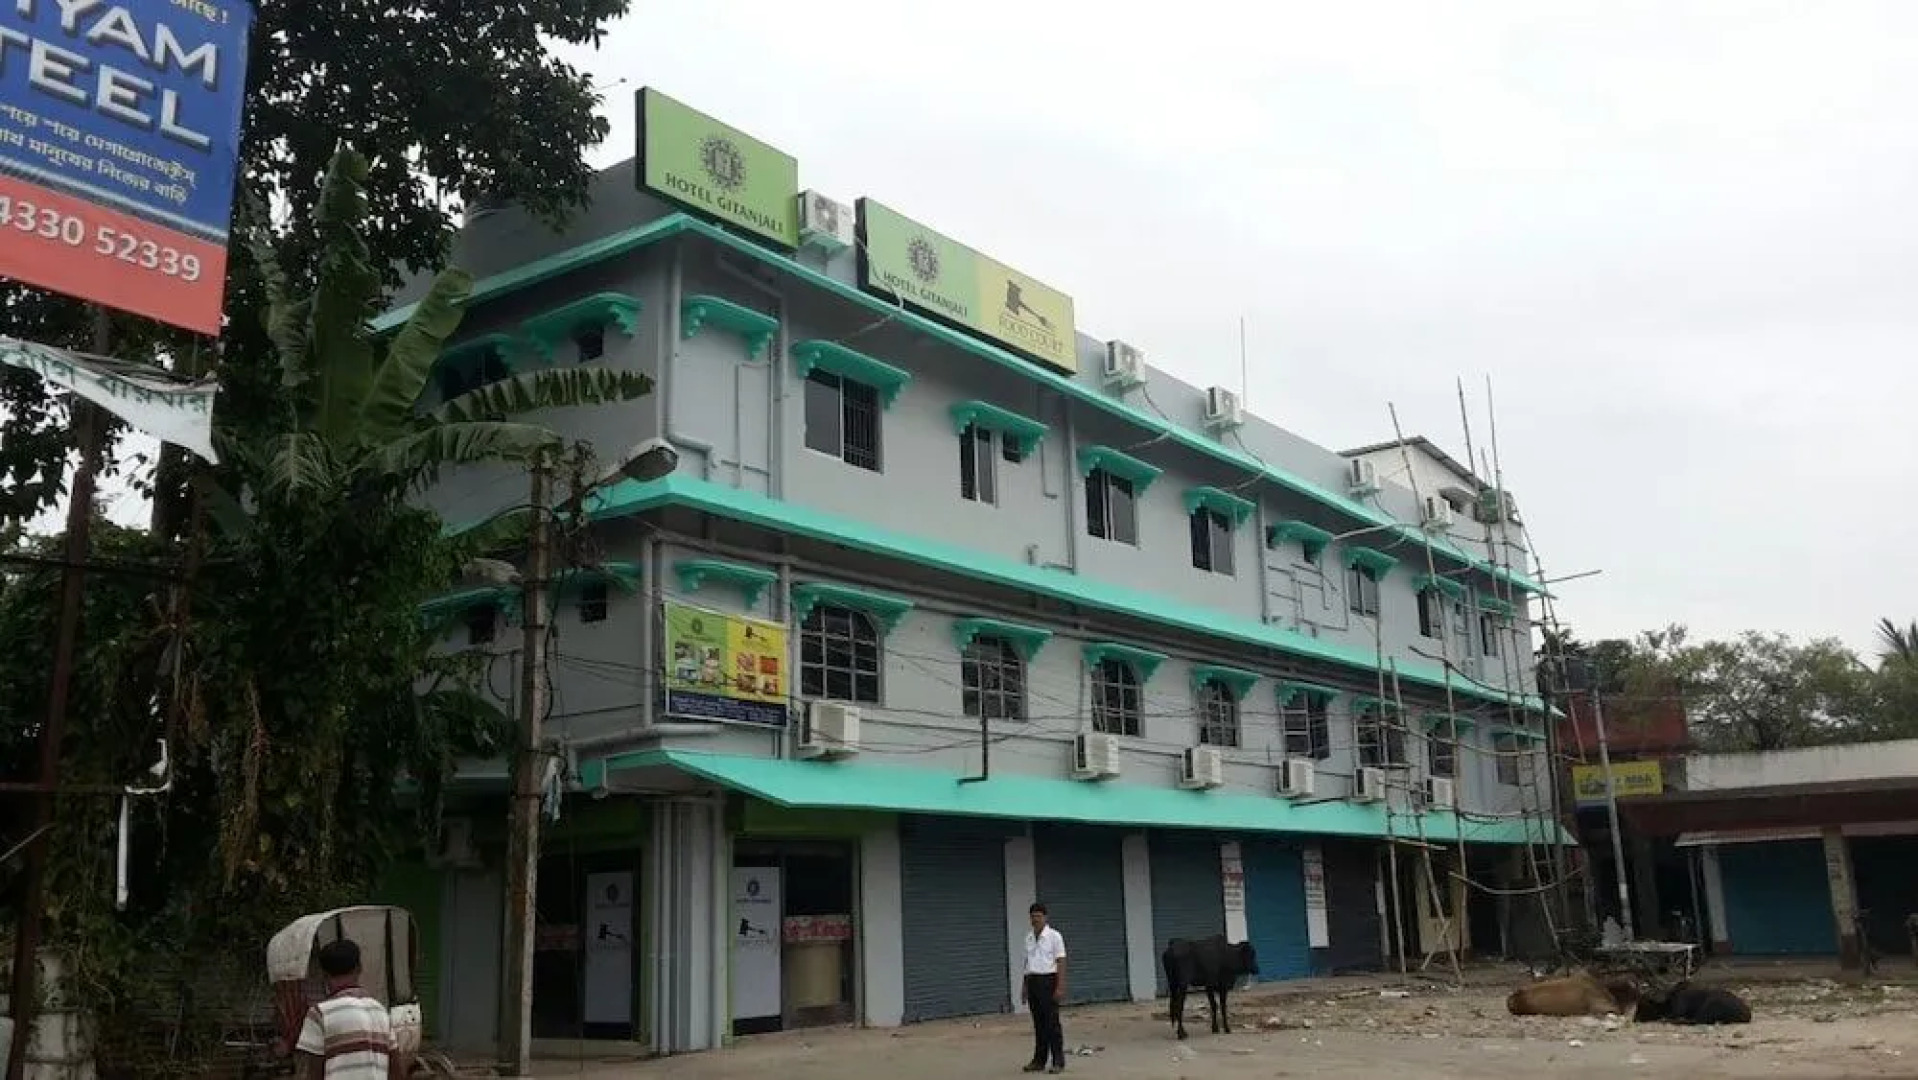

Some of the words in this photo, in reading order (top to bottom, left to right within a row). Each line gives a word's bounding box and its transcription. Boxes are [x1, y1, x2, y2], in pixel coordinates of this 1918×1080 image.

[16, 0, 218, 83] YAM
[664, 171, 712, 204] HOTEL
[0, 195, 85, 246] 4330
[94, 226, 201, 281] 52339
